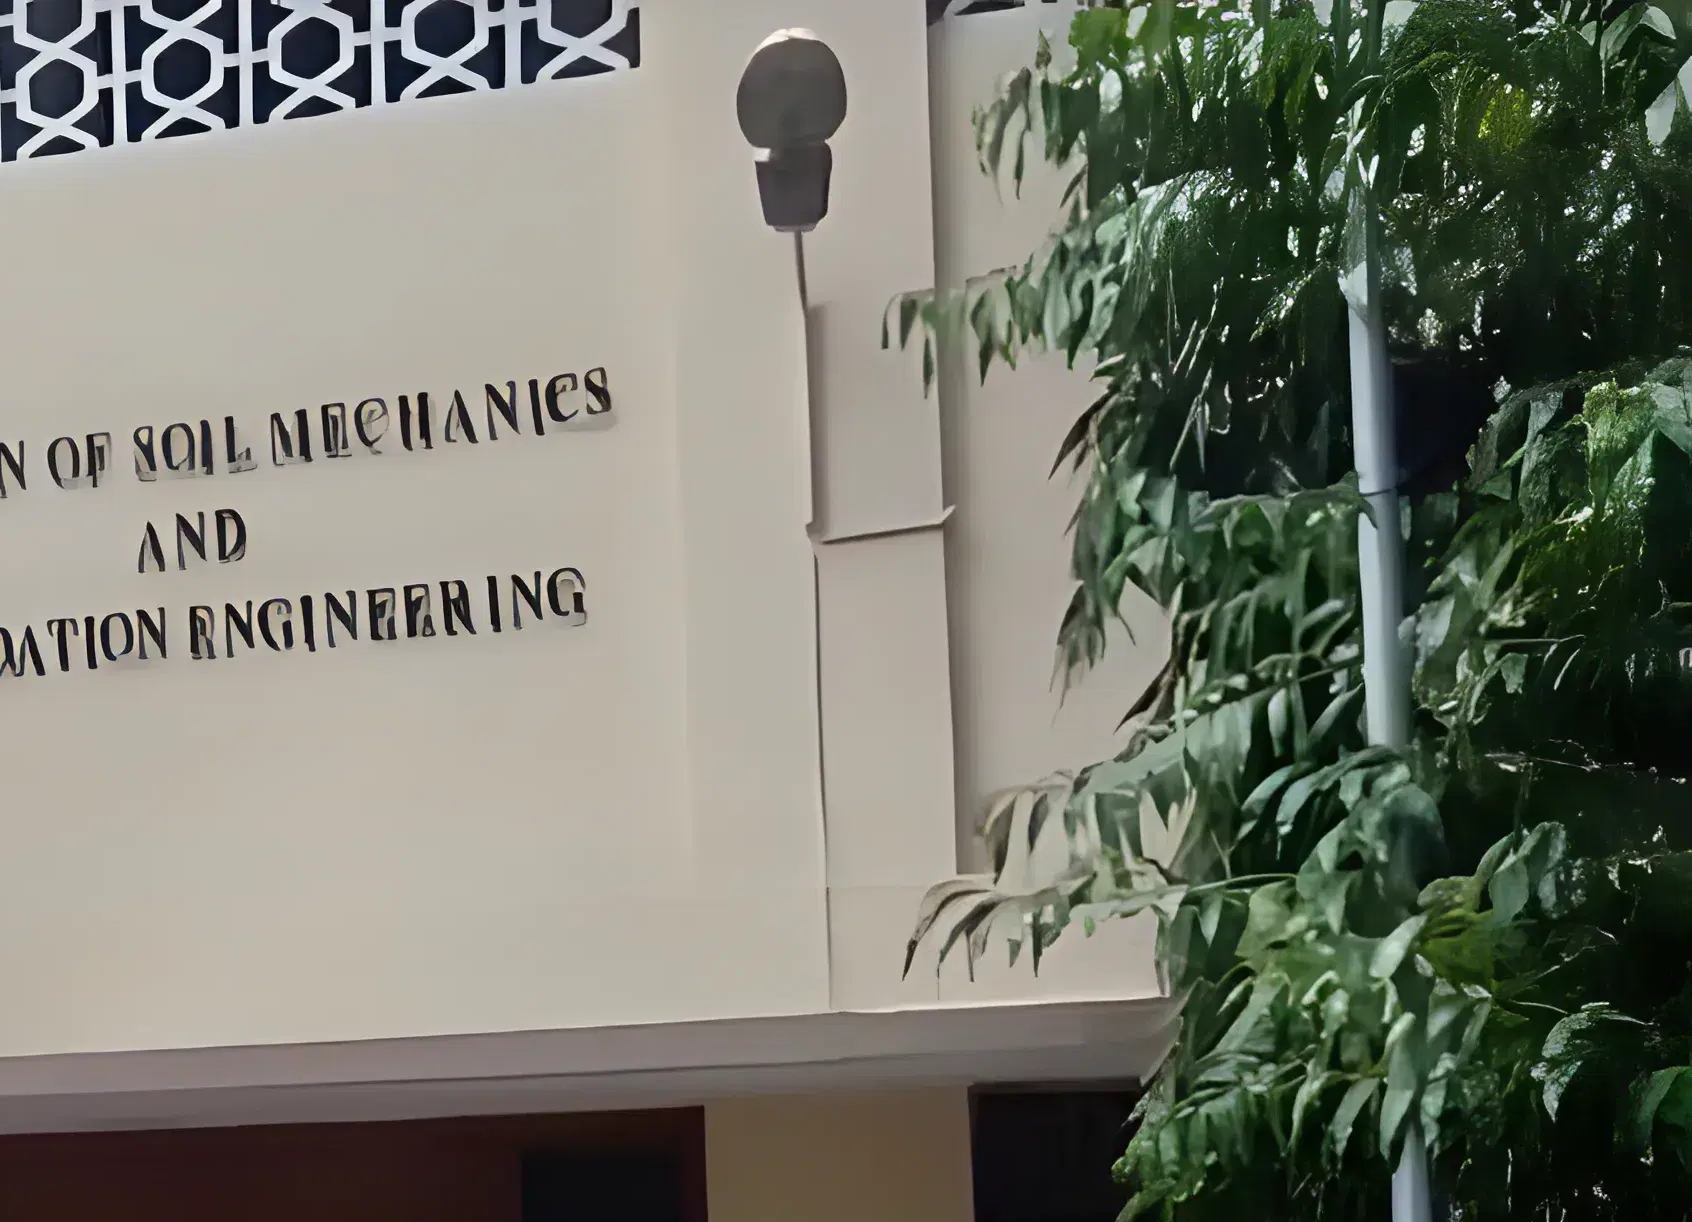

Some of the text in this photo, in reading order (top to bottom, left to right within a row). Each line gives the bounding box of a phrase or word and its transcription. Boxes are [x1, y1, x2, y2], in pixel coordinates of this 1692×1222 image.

[47, 432, 112, 489] OF
[133, 416, 257, 482] SOIL
[270, 367, 613, 466] MECHANICS
[138, 508, 247, 574] AND
[189, 567, 587, 660] ENGINEERING
